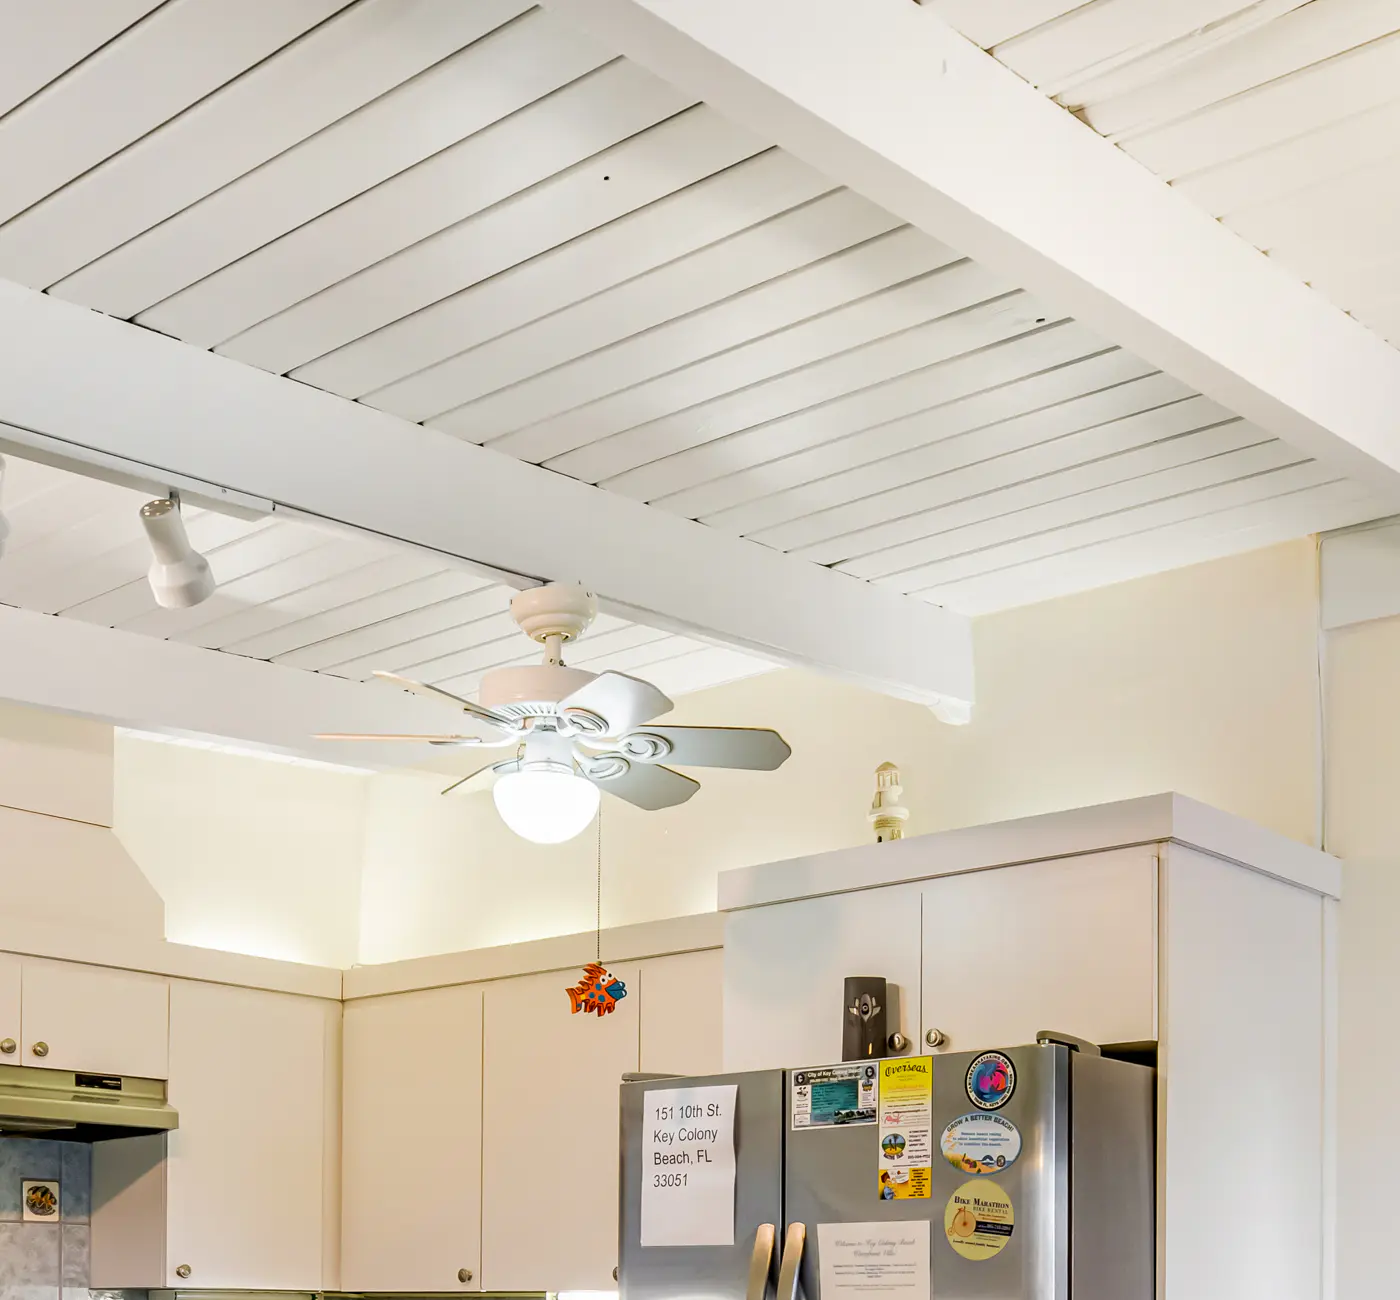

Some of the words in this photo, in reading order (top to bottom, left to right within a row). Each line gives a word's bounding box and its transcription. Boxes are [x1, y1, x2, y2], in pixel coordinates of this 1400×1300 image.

[885, 1064, 929, 1078] Overseas
[655, 1106, 674, 1121] 151
[679, 1104, 703, 1119] 10th
[706, 1103, 722, 1117] St.
[947, 1120, 963, 1132] GROW
[970, 1114, 993, 1122] BETTER
[994, 1117, 1014, 1132] BEACH!
[653, 1129, 675, 1146] Key
[678, 1127, 718, 1143] Colony
[653, 1150, 693, 1166] Beach,
[697, 1149, 713, 1163] FL
[653, 1173, 688, 1188] 33051
[974, 1198, 1009, 1209] MARATHON
